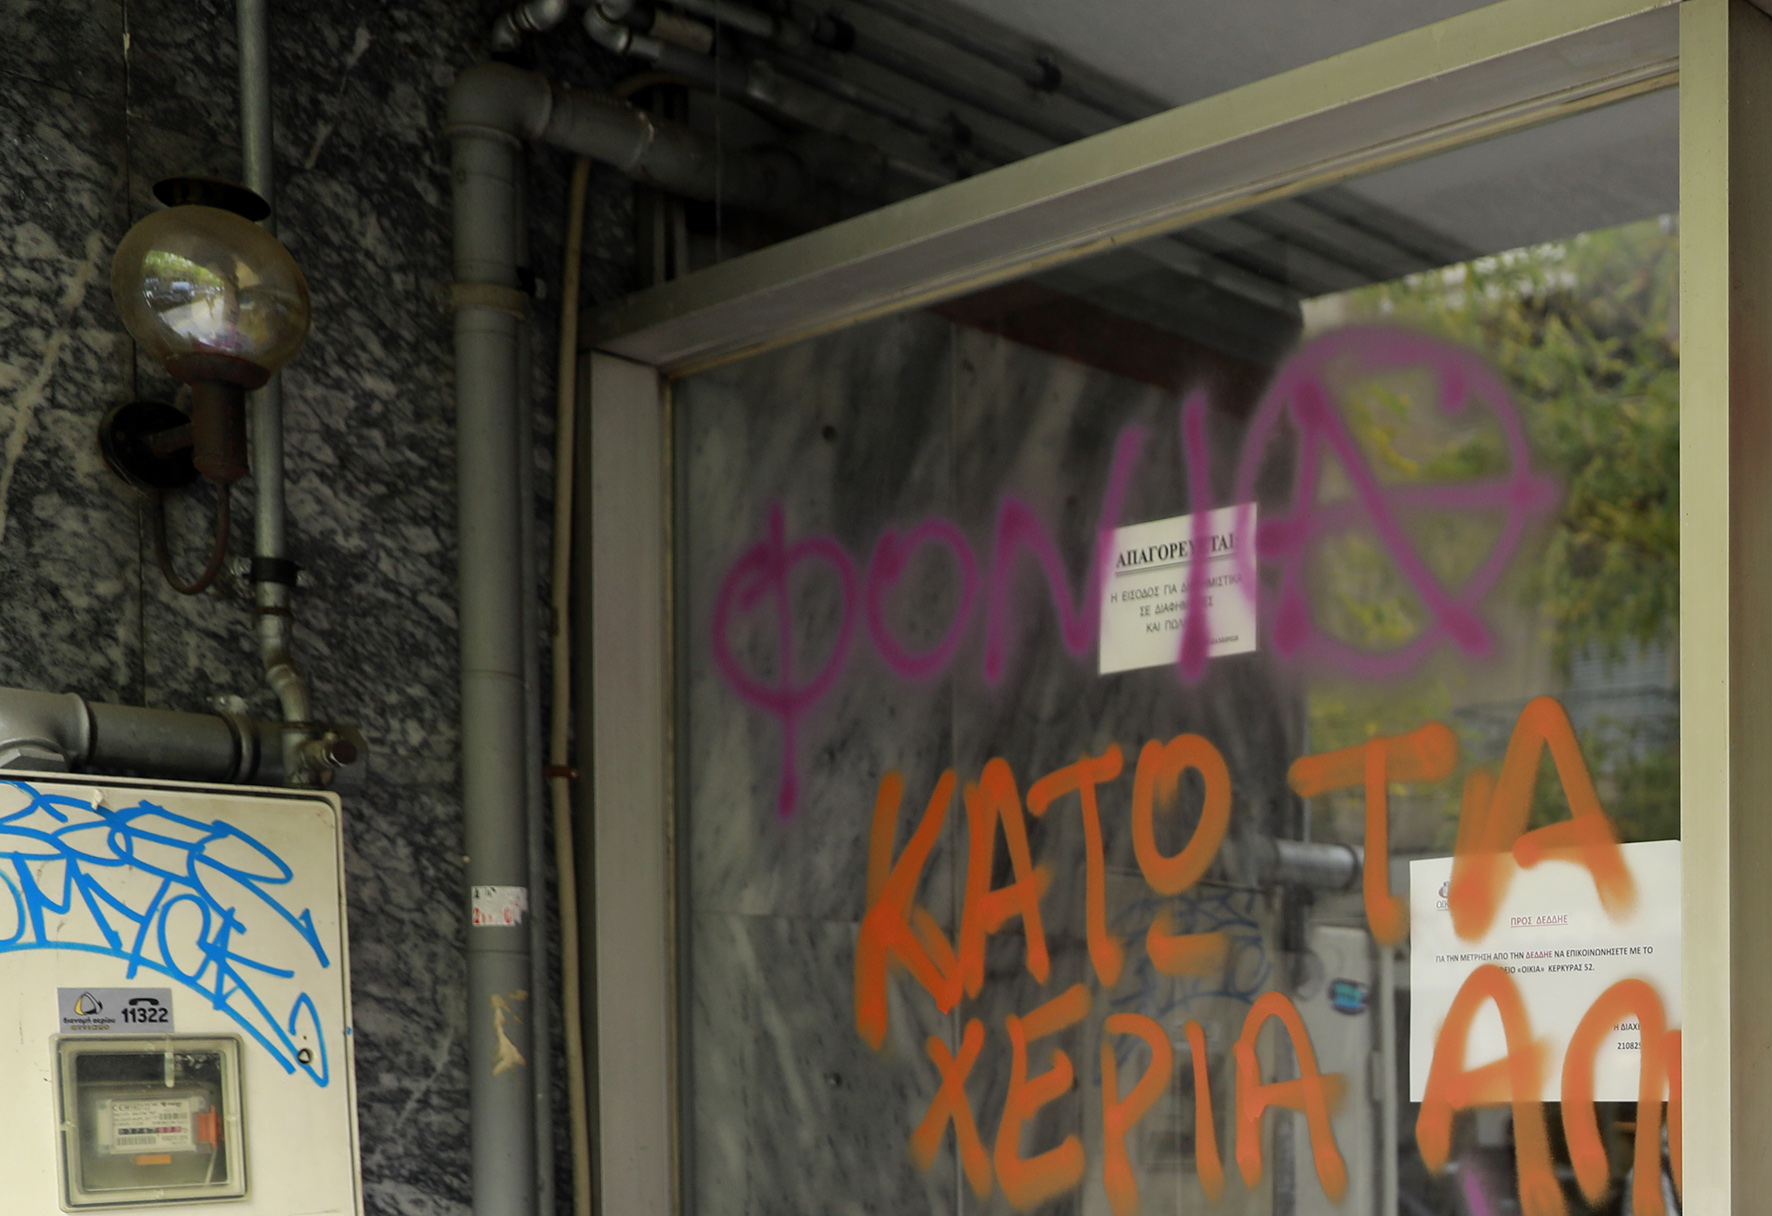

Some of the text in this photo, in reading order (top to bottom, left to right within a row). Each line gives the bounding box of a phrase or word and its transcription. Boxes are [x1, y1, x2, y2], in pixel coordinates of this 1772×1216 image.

[1121, 585, 1159, 603] ΕΙΣΟΔΟΣ
[1163, 584, 1177, 596] ΓΙΑ
[1139, 605, 1150, 617] ΣΕ
[1145, 620, 1161, 634] ΚΑΙ
[1288, 694, 1640, 946] ΤΑ
[1510, 914, 1568, 926] ΠΡΟΣ ΔΕΔΔΗΕ
[1436, 946, 1653, 963] ΓΙΑ ΤΗΝ ΜΕΤΡΗΣΗ ΑΠΟ ΤΗΝ ΔΕΔΔΗΕ ΝΑ ΕΠΙΚΟΙΝΩΝΗΣΕΤΕ ΜΕ ΤΟ
[1548, 963, 1582, 972] ΚΕΡΚΥΡΑΣ
[121, 1007, 169, 1023] 11322
